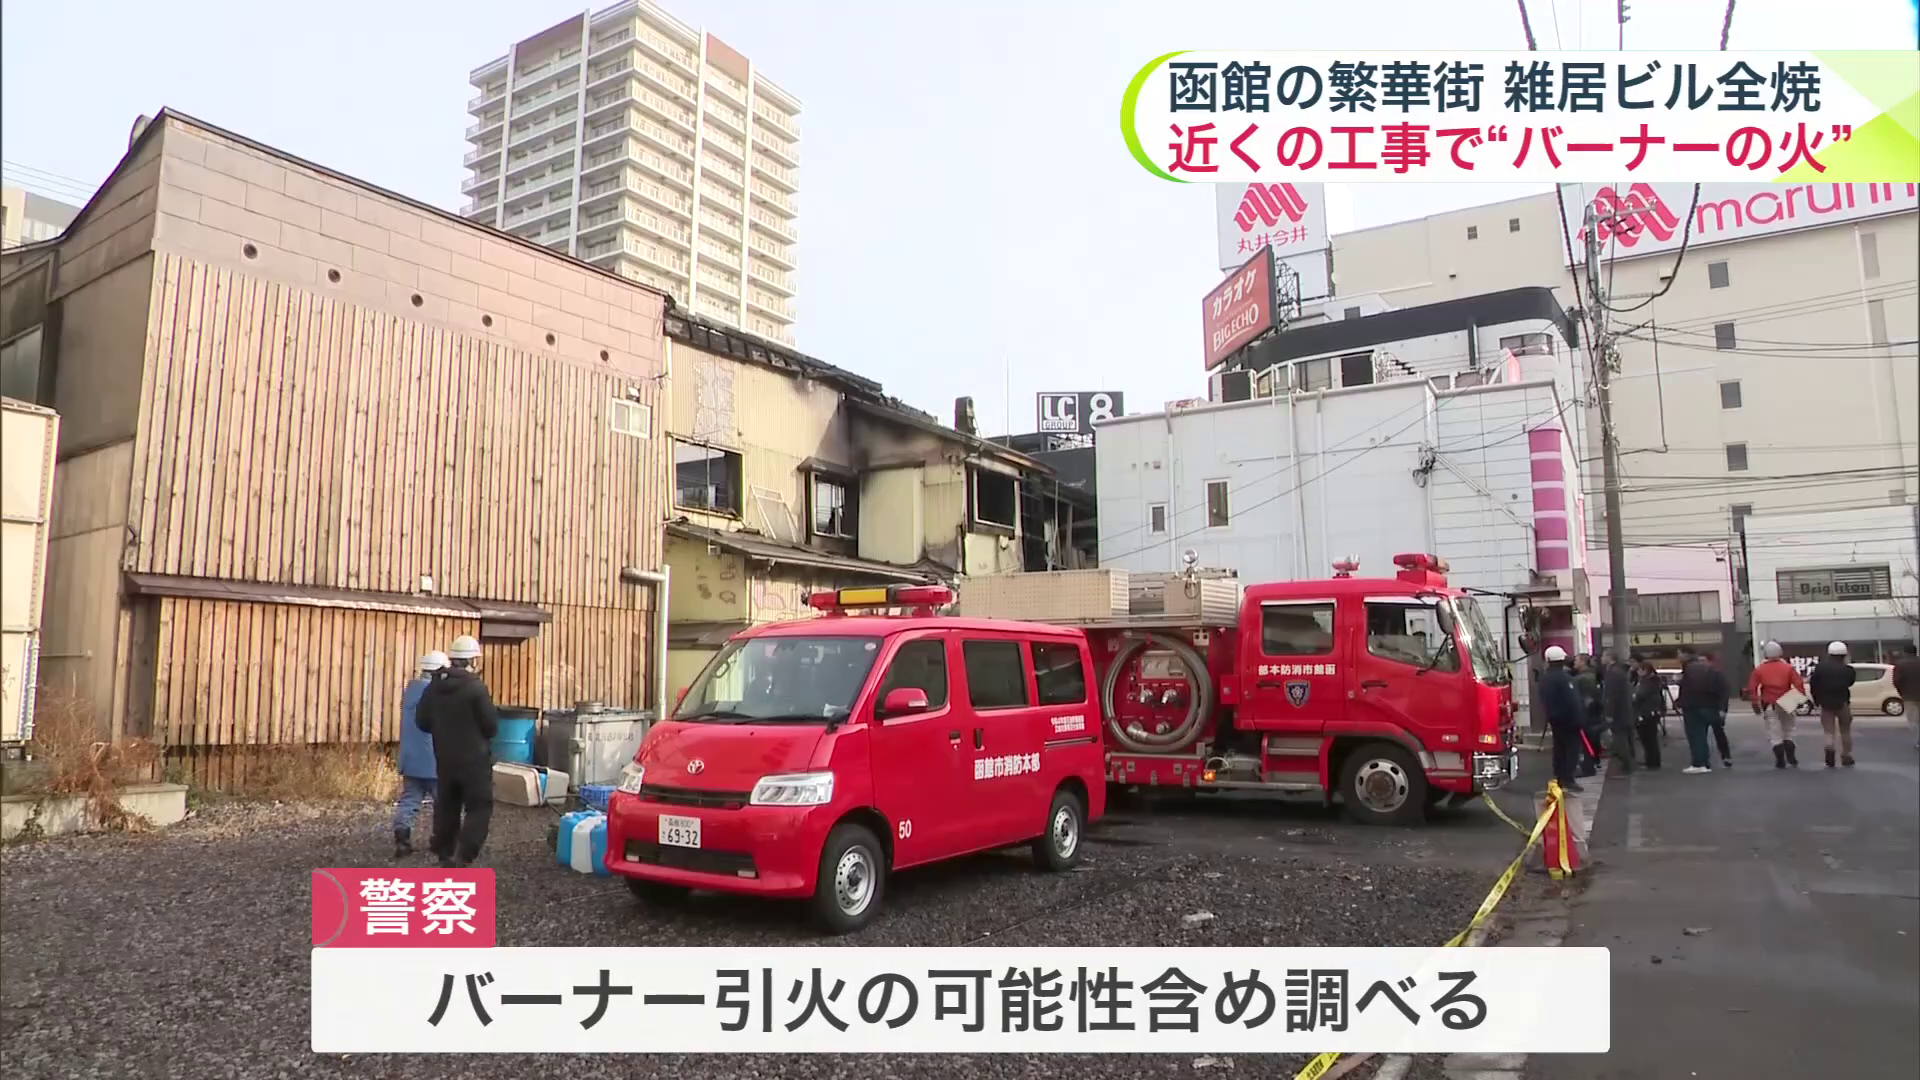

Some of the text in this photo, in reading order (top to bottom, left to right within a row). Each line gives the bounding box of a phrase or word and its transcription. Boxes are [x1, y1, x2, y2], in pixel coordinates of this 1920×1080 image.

[1237, 226, 1309, 254] 丸井今井
[1212, 268, 1257, 320] カラオケ
[1043, 396, 1075, 420] LC
[1044, 420, 1075, 430] GROUP
[974, 752, 1041, 781] 函館市消防本部
[899, 819, 912, 840] 50
